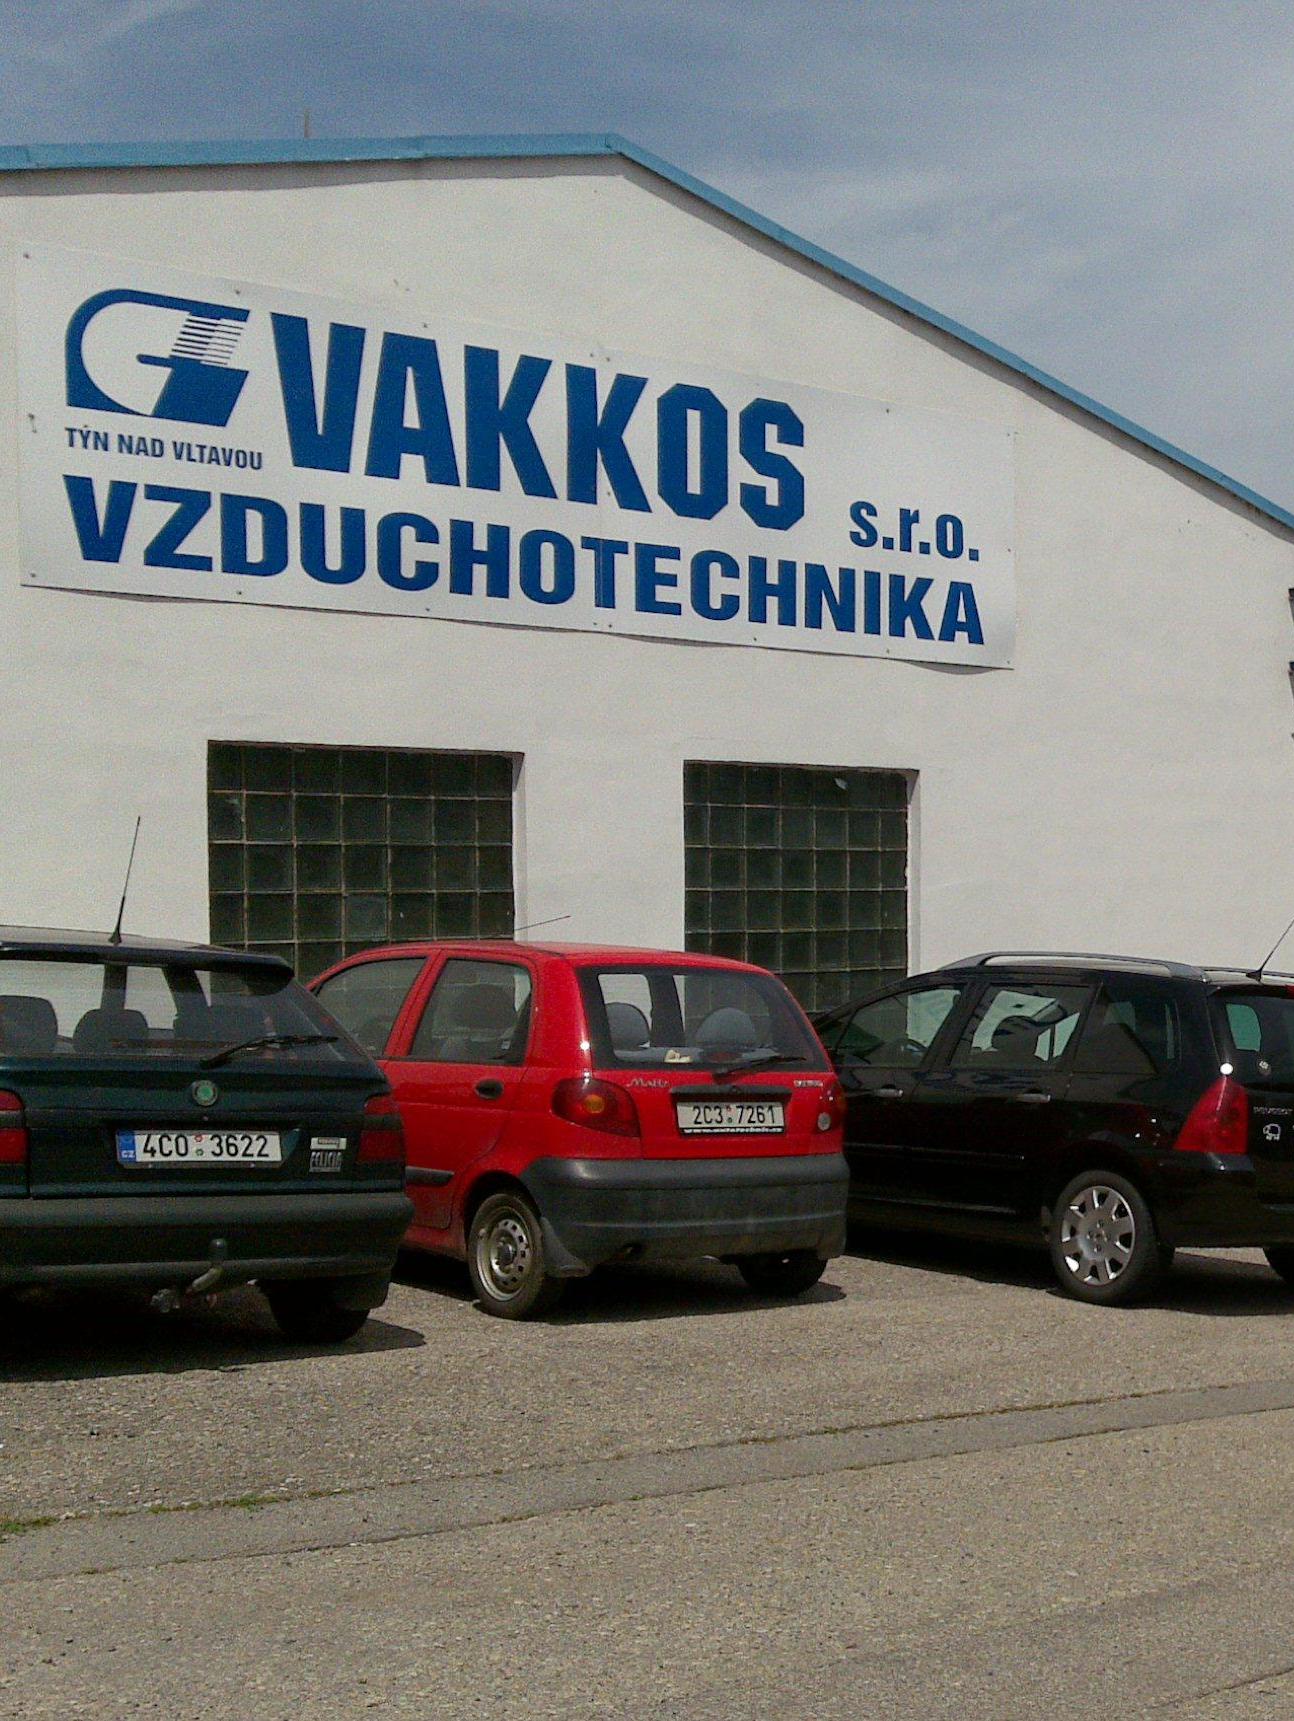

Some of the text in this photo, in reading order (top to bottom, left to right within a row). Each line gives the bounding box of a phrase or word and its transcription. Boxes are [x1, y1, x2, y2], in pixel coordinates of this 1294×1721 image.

[64, 425, 263, 470] TÝN NAD VLTAVOU
[270, 312, 979, 561] VAKKOS s.r.o.
[63, 474, 984, 645] VZDUCHOTECHNIKA
[693, 1105, 775, 1125] 2C3 7261
[121, 1150, 135, 1158] CZ
[210, 1134, 269, 1157] 3622
